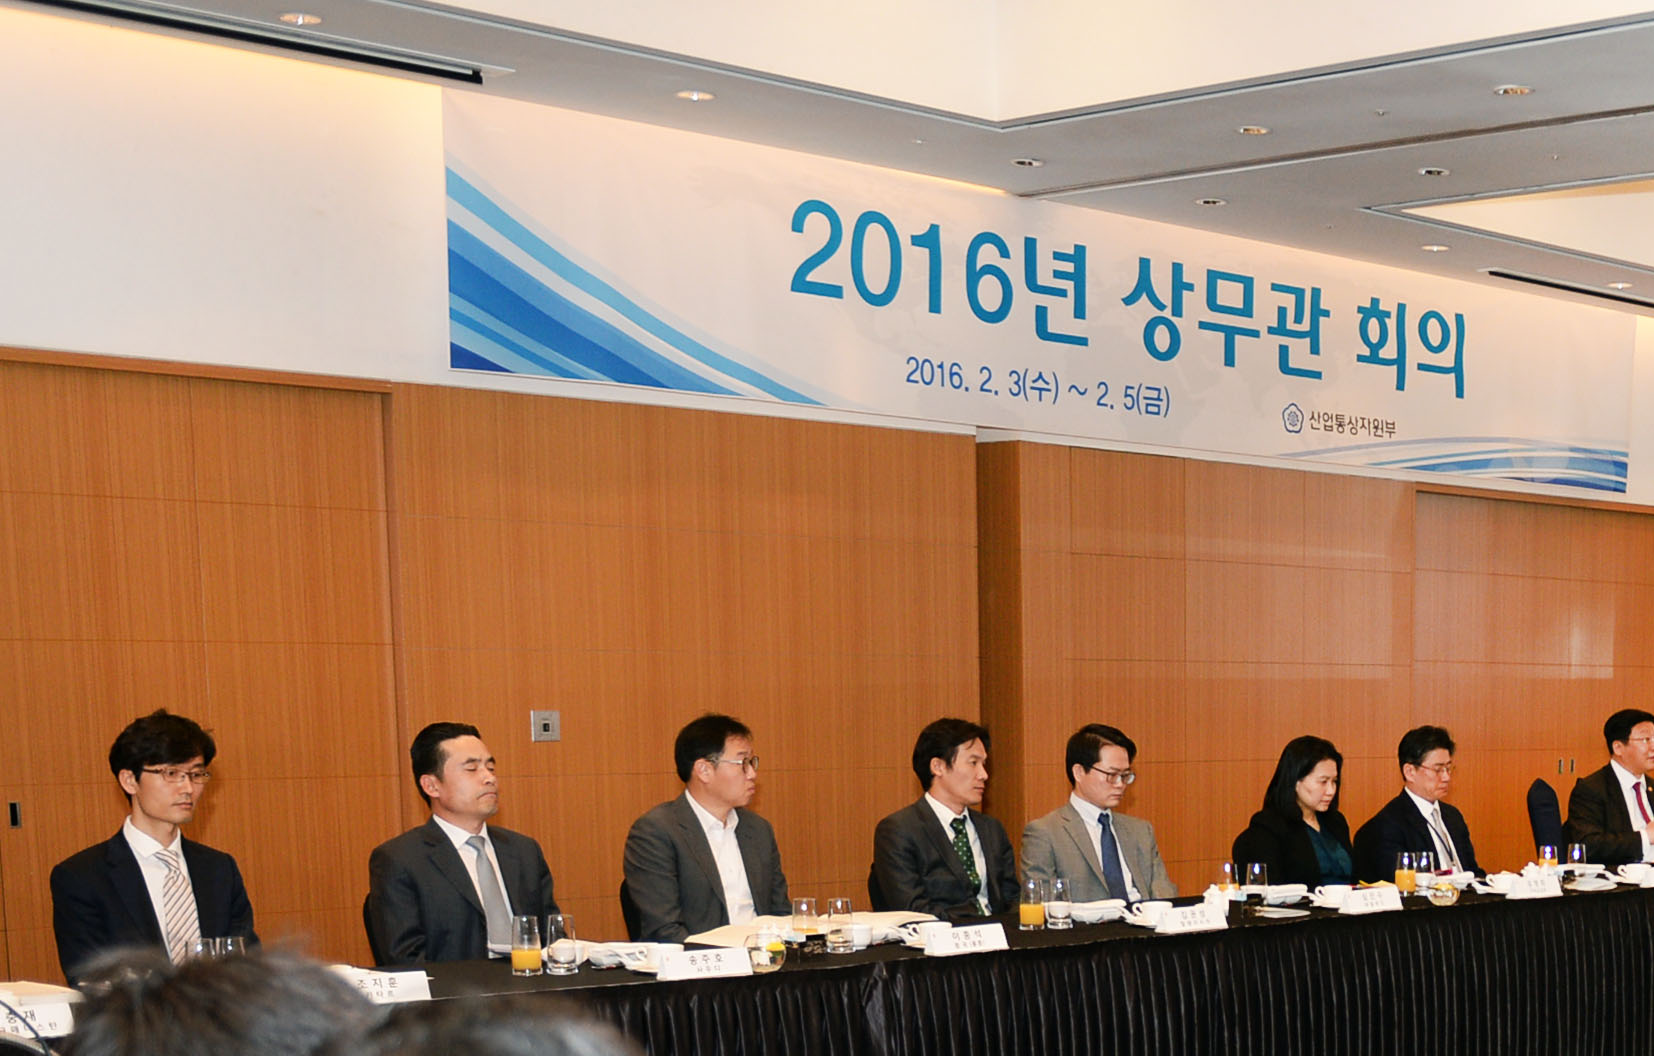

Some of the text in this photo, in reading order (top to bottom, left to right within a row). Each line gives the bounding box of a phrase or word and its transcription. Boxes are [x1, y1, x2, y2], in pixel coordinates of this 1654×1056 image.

[790, 199, 1465, 399] 2016년 상무관 회의
[905, 356, 970, 393] 2016.
[979, 366, 999, 396] 2.
[1008, 368, 1060, 405] 3(수)
[1096, 381, 1115, 410] 2.
[1123, 383, 1171, 418] 5(금)
[1308, 410, 1398, 438] 산업통상자원부
